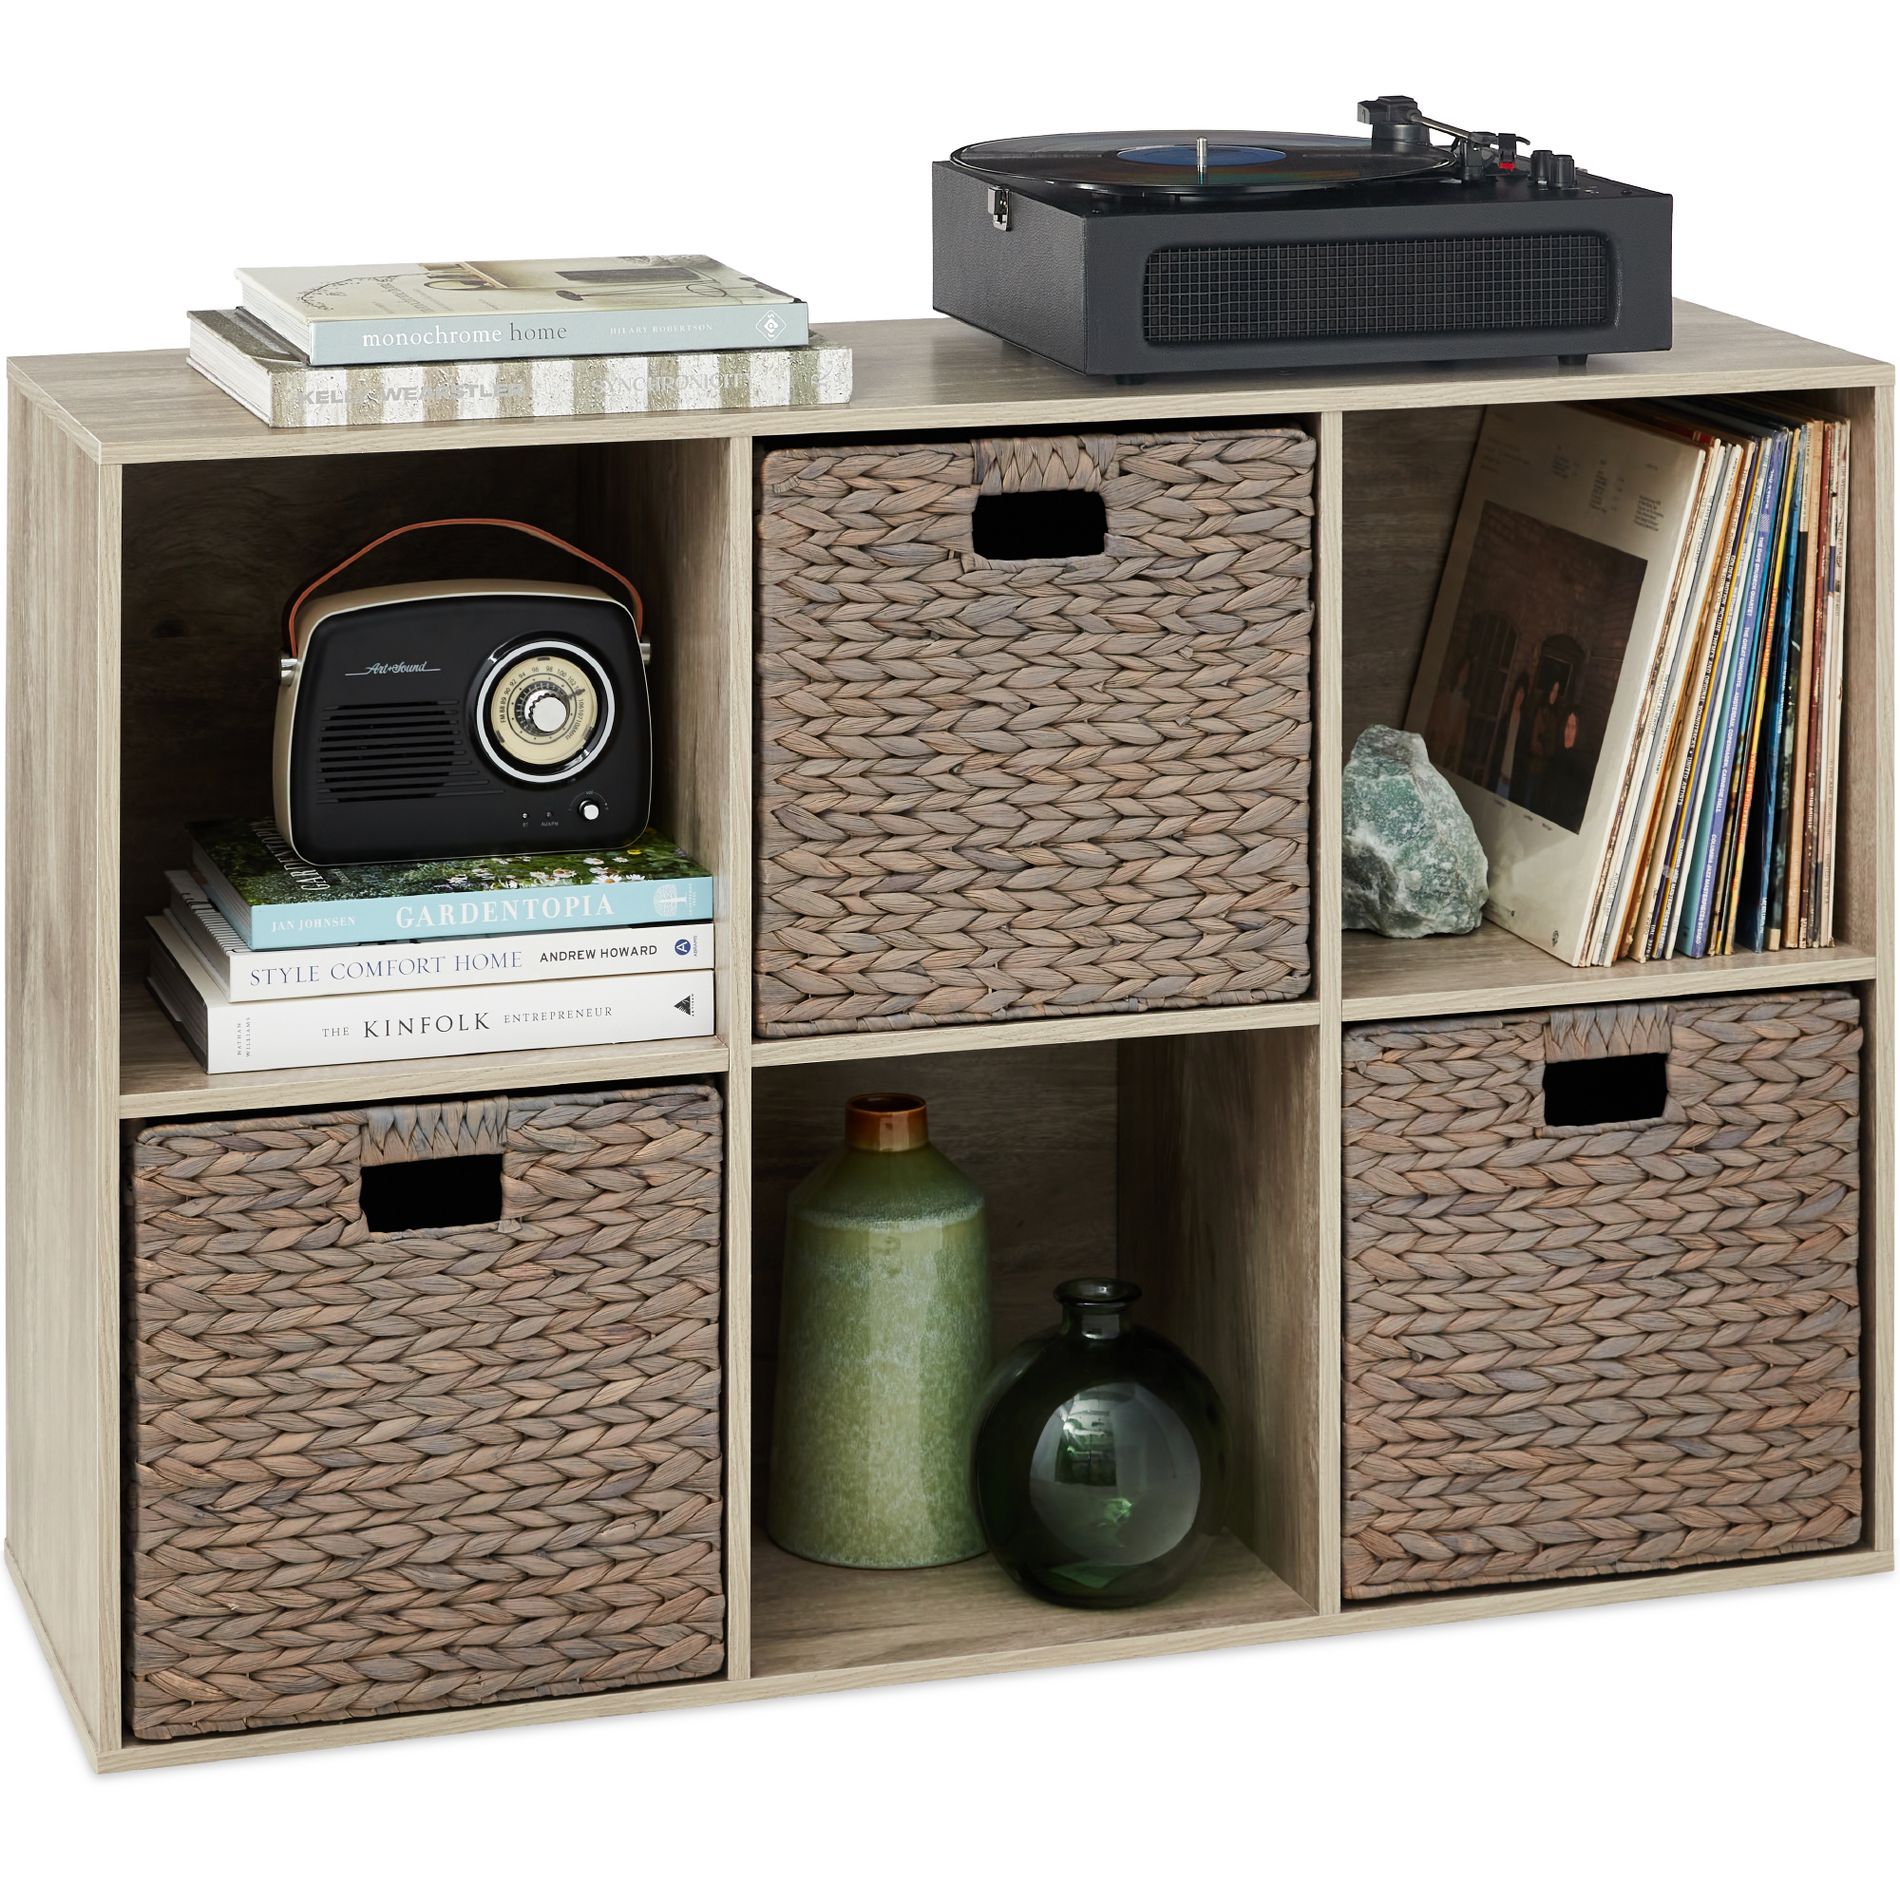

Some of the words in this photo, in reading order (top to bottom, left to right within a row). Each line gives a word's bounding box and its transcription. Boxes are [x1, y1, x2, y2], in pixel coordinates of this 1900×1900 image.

[362, 323, 503, 347] monochrome
[509, 322, 567, 342] home
[609, 327, 648, 336] HILARY
[652, 323, 713, 334] ROBERTSON
[1745, 590, 1756, 616] QUARTET
[1715, 798, 1723, 813] HALL
[396, 892, 616, 930] GARDENTOPIA
[1698, 878, 1710, 921] MASTERPIECES
[272, 920, 294, 933] JAN
[299, 916, 356, 932] JOHNSEN
[249, 966, 320, 988] STYLE
[330, 956, 446, 981] COMFORT
[455, 951, 523, 971] HOME
[540, 948, 596, 964] ANDREW
[600, 945, 659, 960] HOWARD
[322, 1025, 350, 1039] THE
[363, 1013, 491, 1039] KINFOLK
[504, 1006, 613, 1024] ENTREPRENEUR
